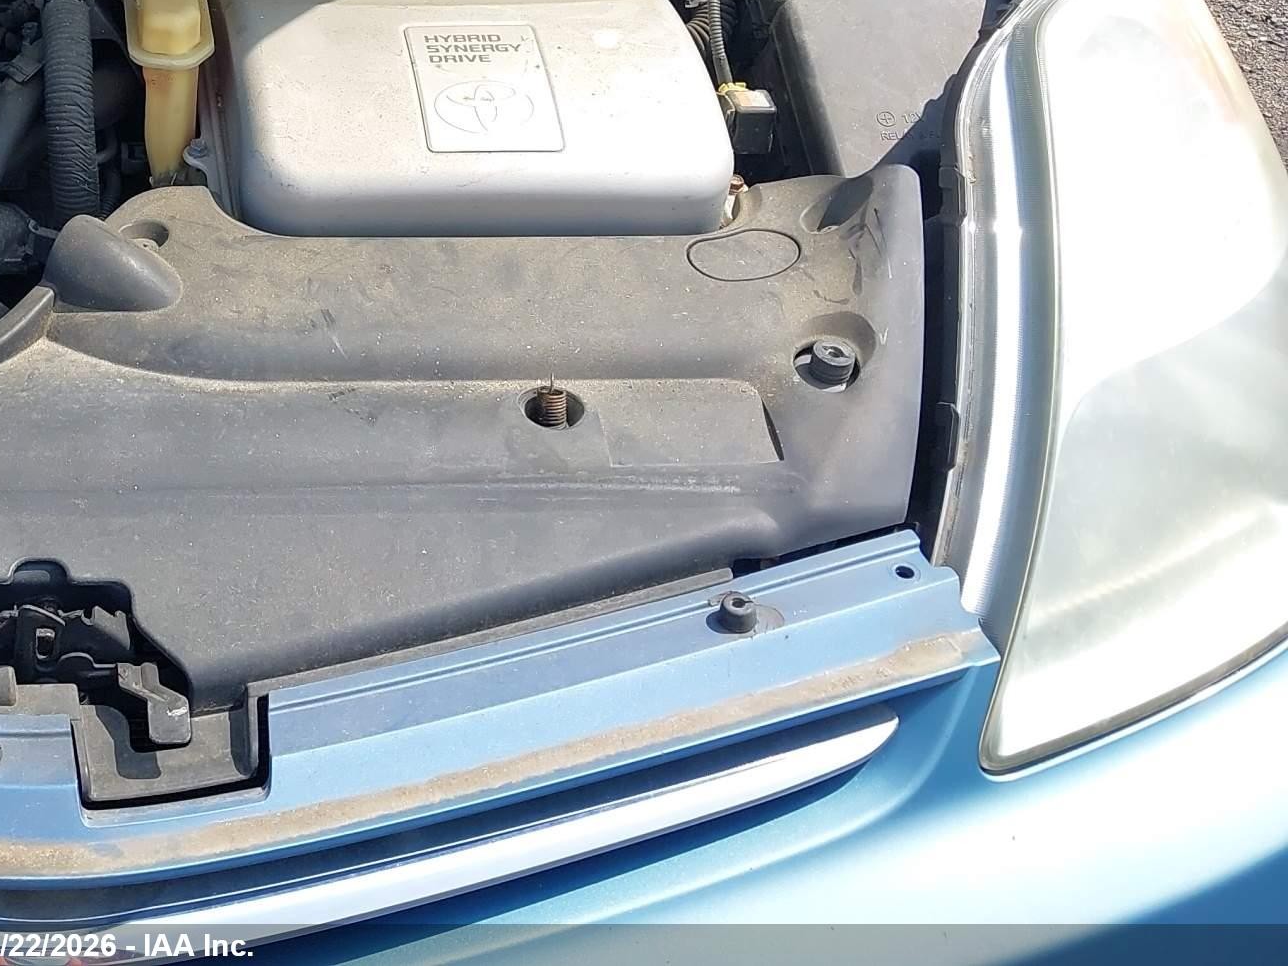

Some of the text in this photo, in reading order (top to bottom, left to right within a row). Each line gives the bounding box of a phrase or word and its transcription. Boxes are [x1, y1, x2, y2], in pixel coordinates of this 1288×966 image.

[424, 34, 502, 43] HYBRID
[426, 44, 521, 53] SYNERGY
[428, 55, 492, 63] DRIVE
